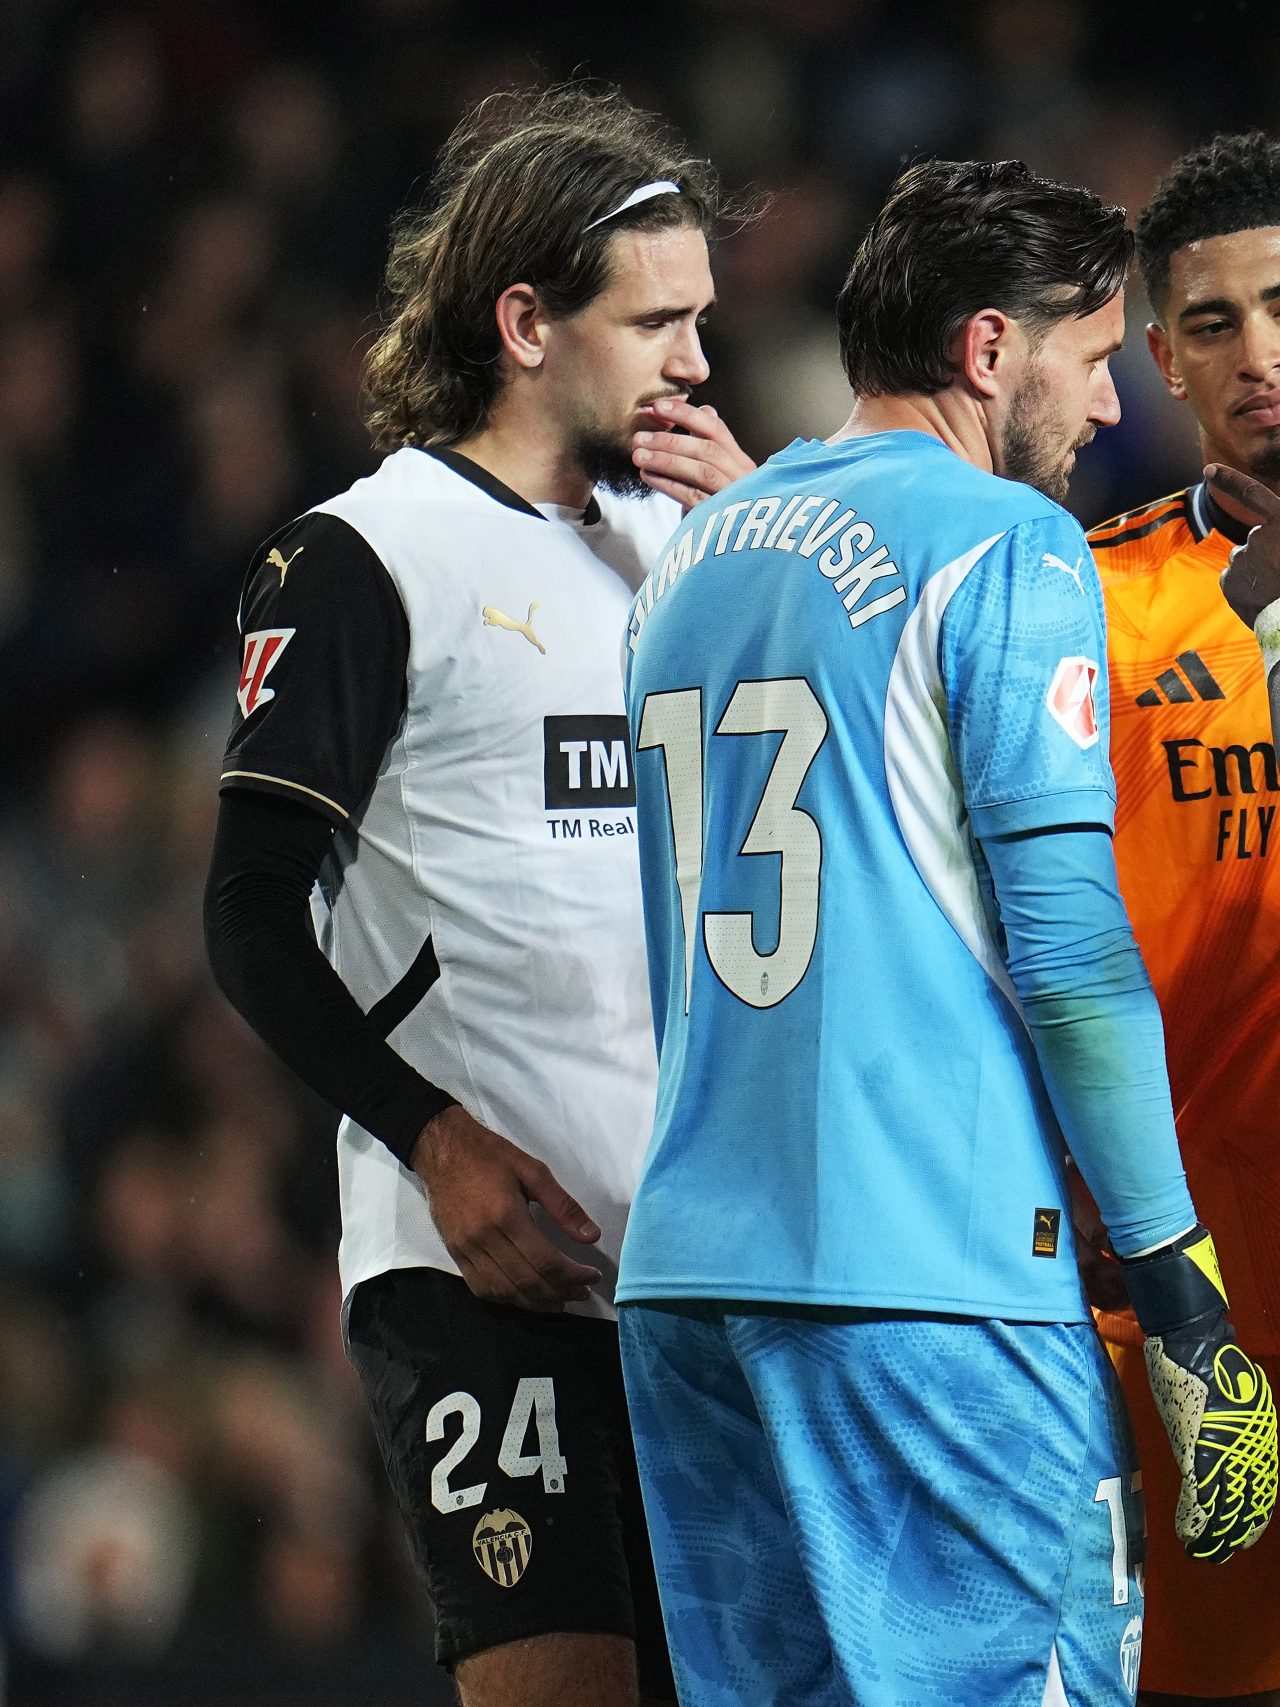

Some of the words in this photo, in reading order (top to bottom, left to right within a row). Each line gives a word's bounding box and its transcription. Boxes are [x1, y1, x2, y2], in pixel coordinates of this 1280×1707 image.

[559, 740, 629, 789] TM
[546, 819, 583, 839] TM
[588, 816, 635, 838] Real
[635, 675, 830, 1018] 13
[1216, 805, 1276, 862] FLY
[425, 1376, 568, 1514] 24
[477, 1533, 512, 1546] VALENCIA
